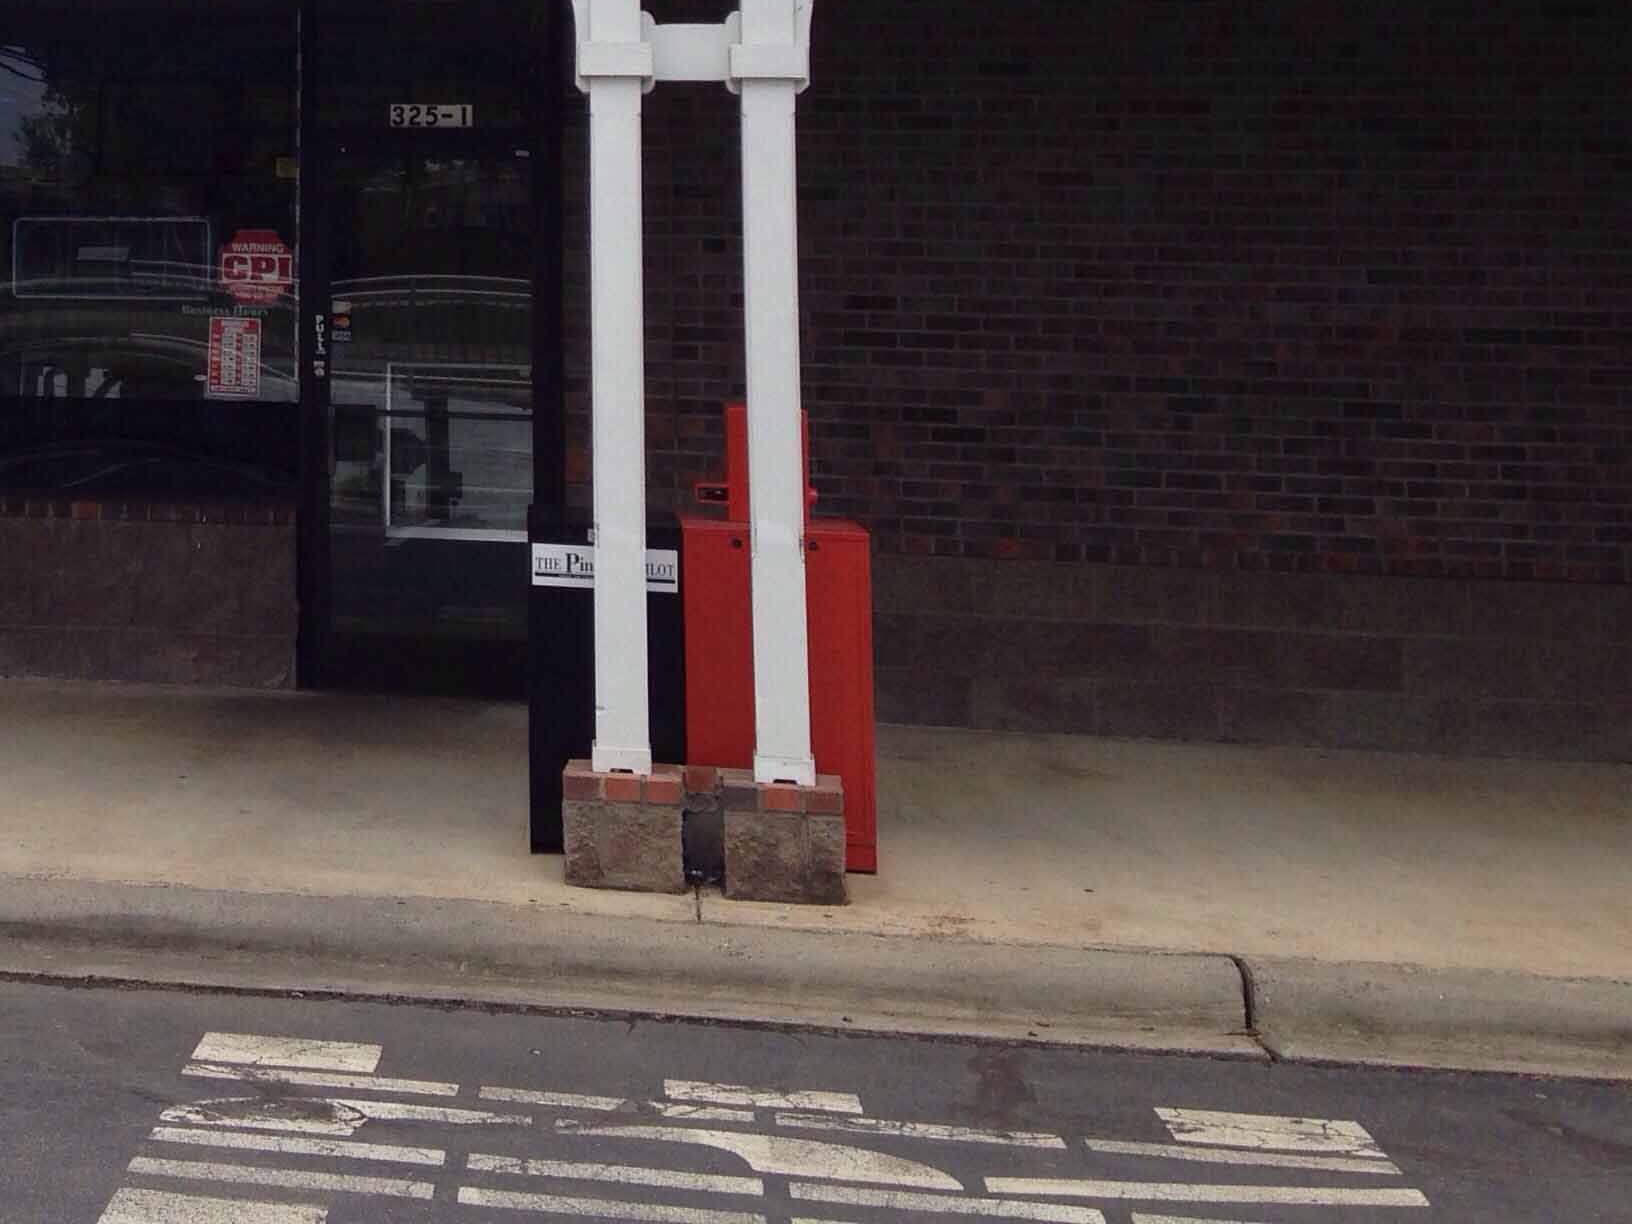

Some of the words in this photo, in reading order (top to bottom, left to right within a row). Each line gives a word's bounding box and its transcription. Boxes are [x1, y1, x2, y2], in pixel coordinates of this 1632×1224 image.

[392, 105, 467, 126] 325-1
[231, 242, 284, 254] WARNING
[224, 256, 291, 281] CPI
[535, 556, 562, 570] THE
[646, 562, 675, 577] ILOT
